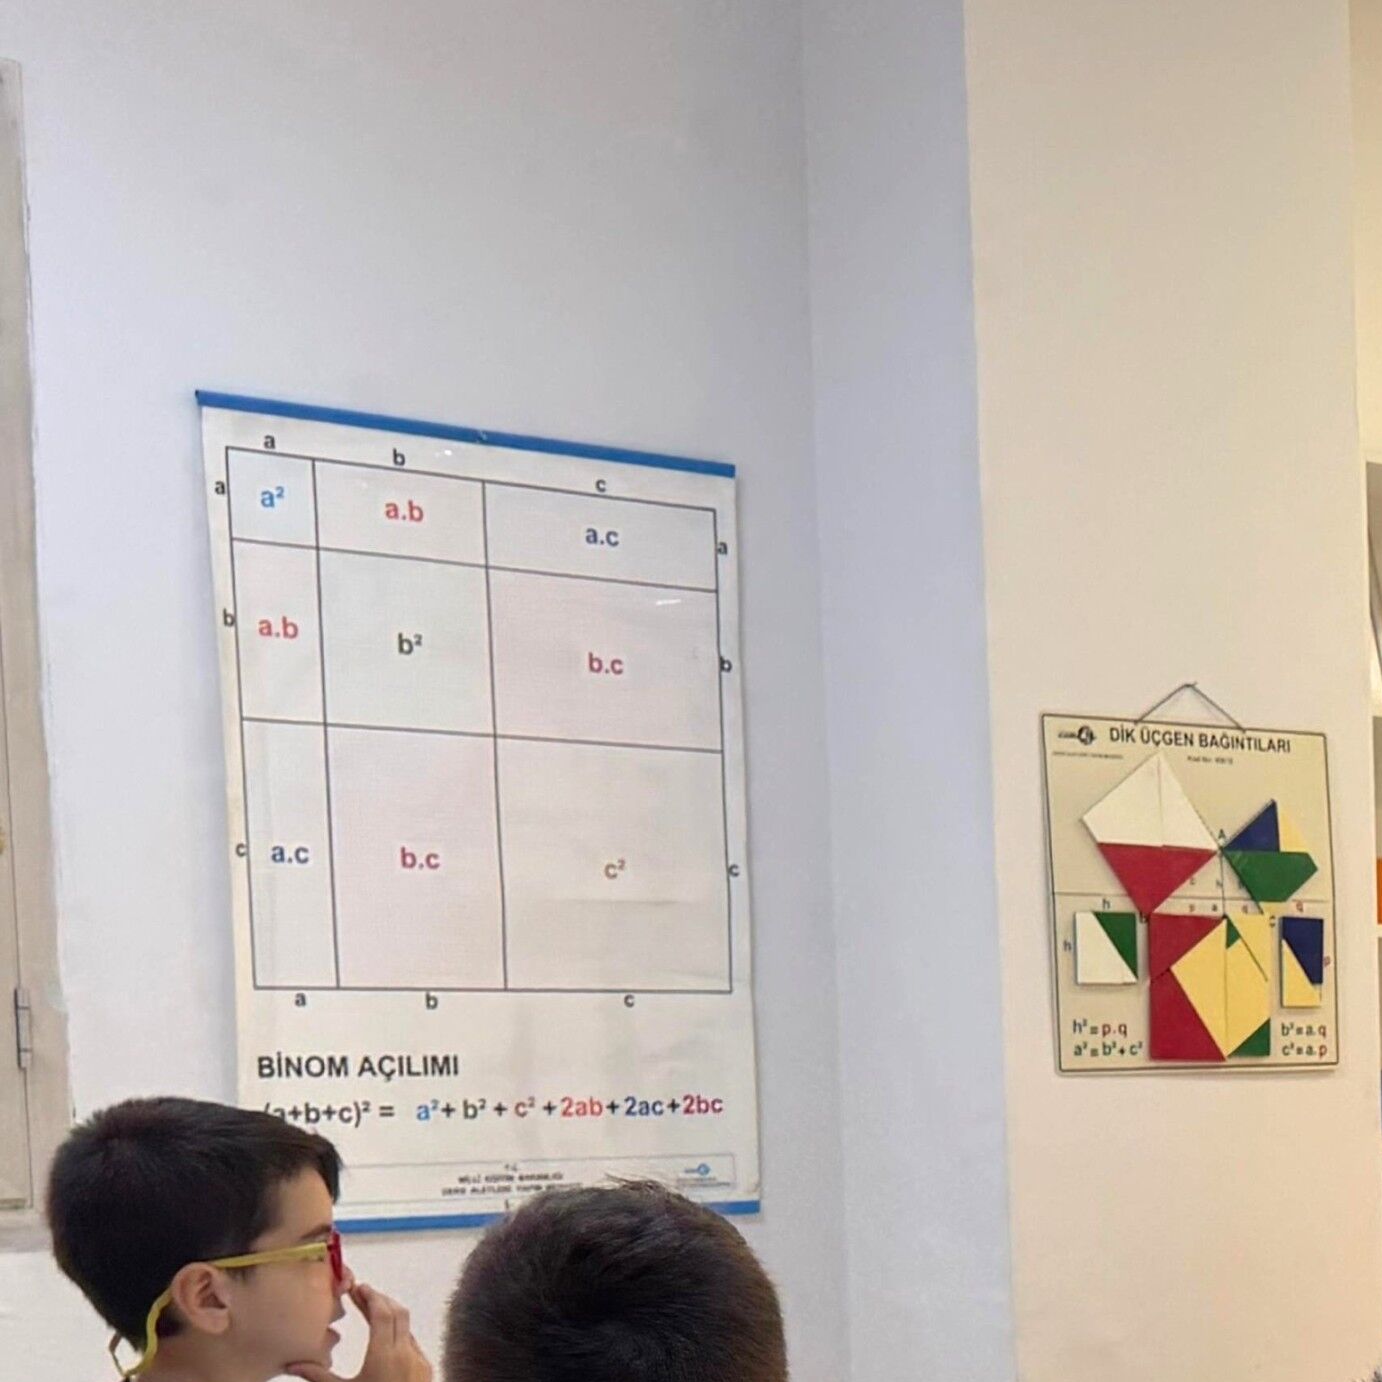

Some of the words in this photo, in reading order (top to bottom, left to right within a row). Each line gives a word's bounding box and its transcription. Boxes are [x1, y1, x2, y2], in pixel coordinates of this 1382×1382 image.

[264, 435, 276, 449] a
[393, 448, 405, 466] b
[215, 481, 226, 495] a
[595, 479, 607, 493] c
[385, 500, 424, 522] a.b
[585, 527, 619, 547] a.c
[717, 541, 728, 555] a
[223, 609, 235, 627] b
[259, 617, 298, 639] a.b
[588, 652, 624, 675] b.c
[719, 656, 732, 672] b
[1109, 724, 1136, 745] DİK
[1140, 726, 1194, 748] ÜÇGEN
[1199, 731, 1291, 754] BAĞINTILARI
[236, 843, 246, 857] c
[271, 844, 309, 864] a.c
[401, 848, 440, 869] b.c
[729, 864, 740, 876] c
[295, 993, 306, 1007] a
[426, 992, 438, 1010] b
[624, 994, 635, 1008] c
[257, 1052, 348, 1079] BİNOM
[358, 1054, 459, 1082] AÇILIMI
